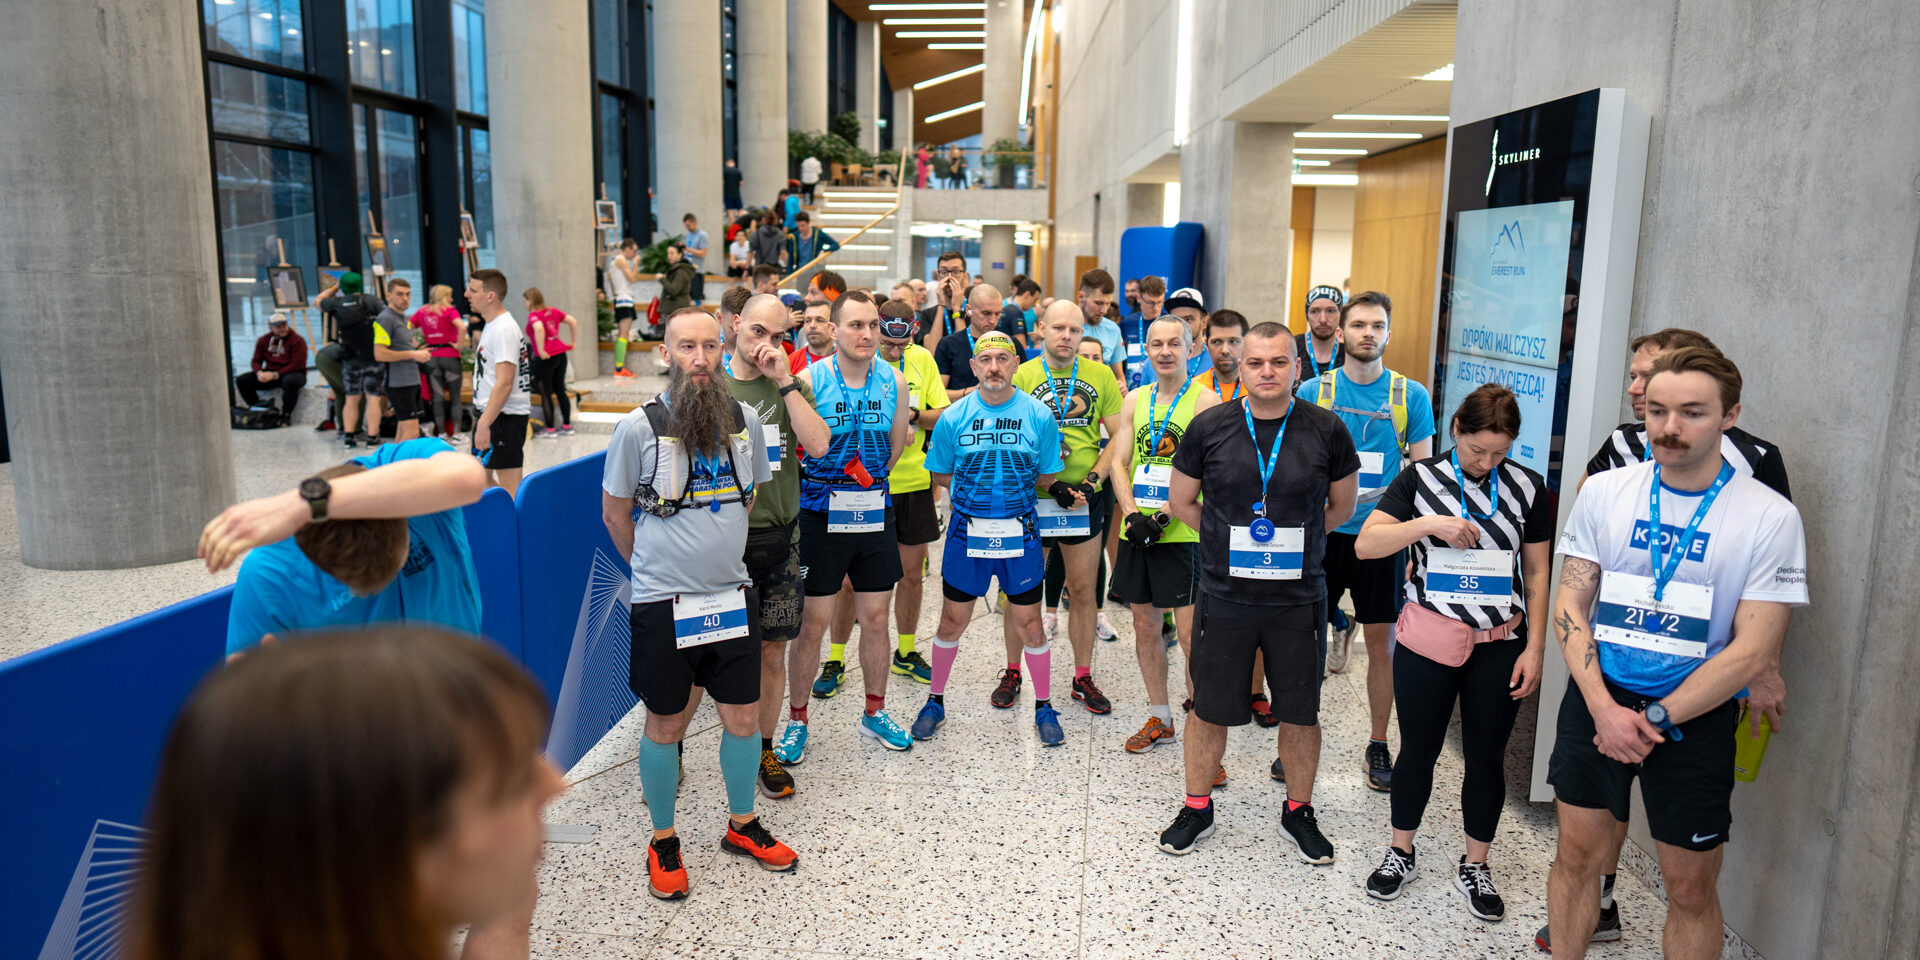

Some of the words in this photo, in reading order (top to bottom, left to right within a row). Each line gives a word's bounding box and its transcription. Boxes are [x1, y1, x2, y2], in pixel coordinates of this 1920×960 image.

[1498, 148, 1541, 166] SKYLINER
[1491, 265, 1513, 276] EVEREST
[1513, 265, 1526, 276] RUN
[1462, 325, 1493, 351] DOPÓKI
[1494, 332, 1547, 360] WALCZYSZ
[1456, 360, 1487, 385] JESTEŚ
[1064, 379, 1098, 397] MOCINY
[958, 432, 1034, 447] ORION
[1147, 486, 1158, 496] 31
[852, 511, 864, 521] 15
[1056, 516, 1068, 526] 13
[988, 537, 1002, 548] 29
[1263, 552, 1272, 565] 3
[1443, 563, 1469, 571] Małgorzata
[1776, 566, 1805, 574] Dedica
[1459, 575, 1479, 589] 35
[1775, 576, 1805, 584] People
[763, 597, 799, 609] STRONG
[763, 607, 799, 619] BRAVE
[703, 614, 721, 628] 40
